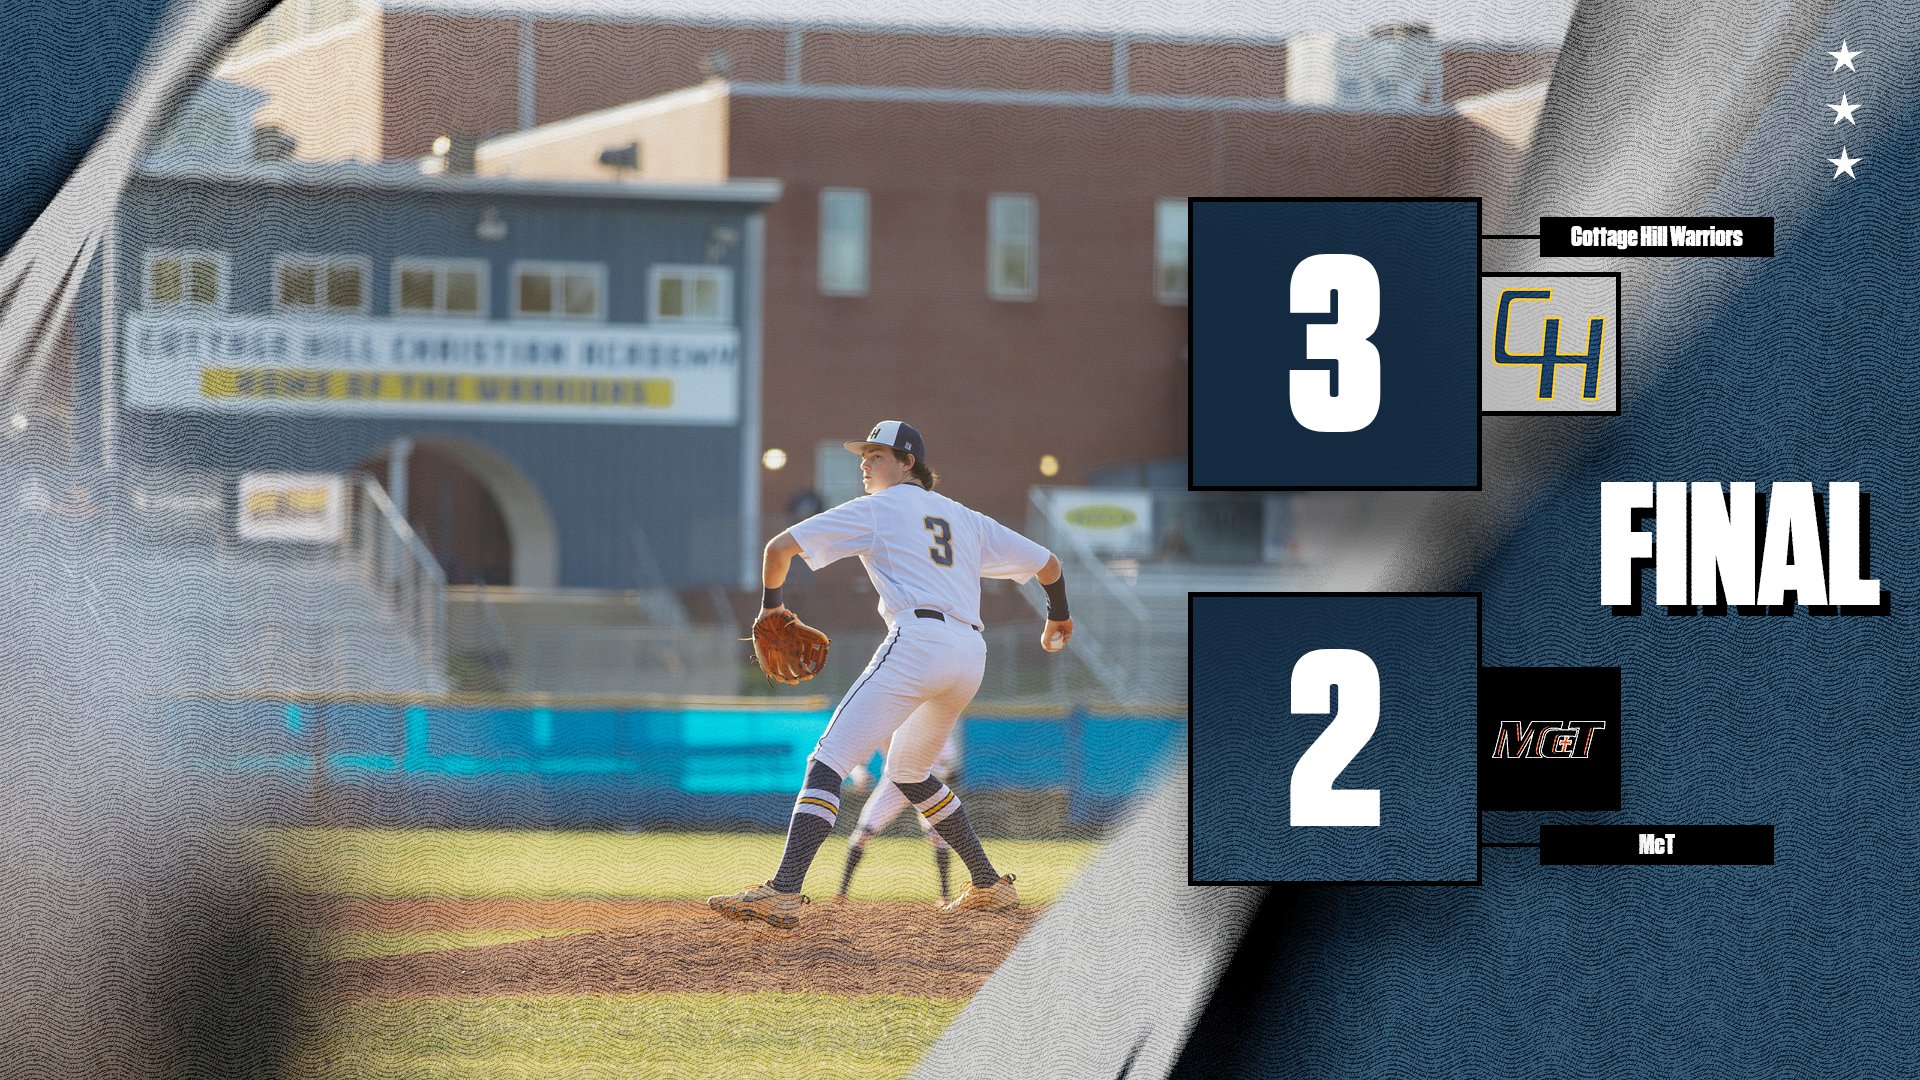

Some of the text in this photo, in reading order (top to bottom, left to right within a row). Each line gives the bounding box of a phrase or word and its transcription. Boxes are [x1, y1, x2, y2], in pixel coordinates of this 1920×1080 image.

[391, 335, 570, 367] CHRISTIAN
[347, 373, 384, 400] OF
[399, 374, 460, 402] THE
[478, 376, 648, 405] WARRIORS
[923, 514, 955, 569] 3
